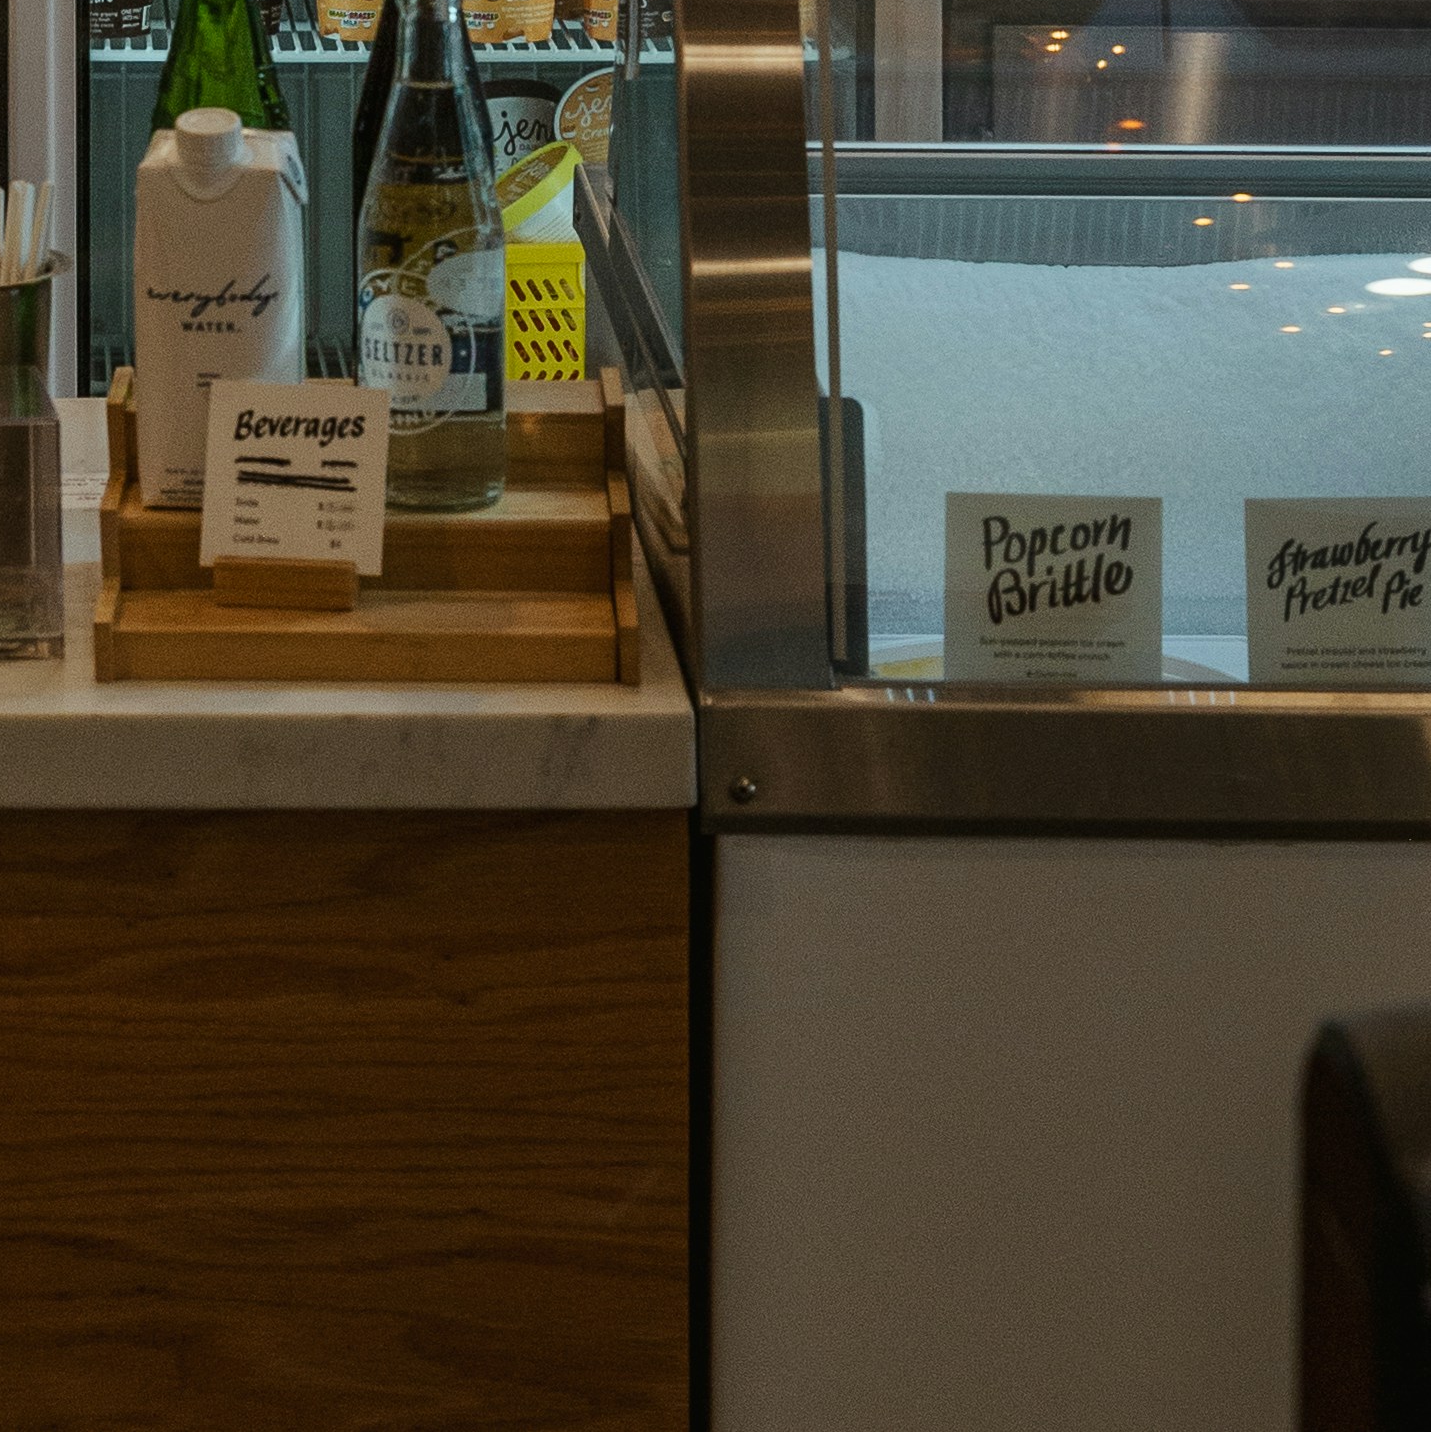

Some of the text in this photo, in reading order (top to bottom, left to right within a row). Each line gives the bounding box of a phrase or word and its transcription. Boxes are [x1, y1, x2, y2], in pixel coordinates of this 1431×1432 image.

[234, 409, 365, 448] Beverages
[982, 514, 1132, 578] Popcorn
[988, 552, 1133, 625] Brittle
[1284, 562, 1424, 622] Pretzel Pie
